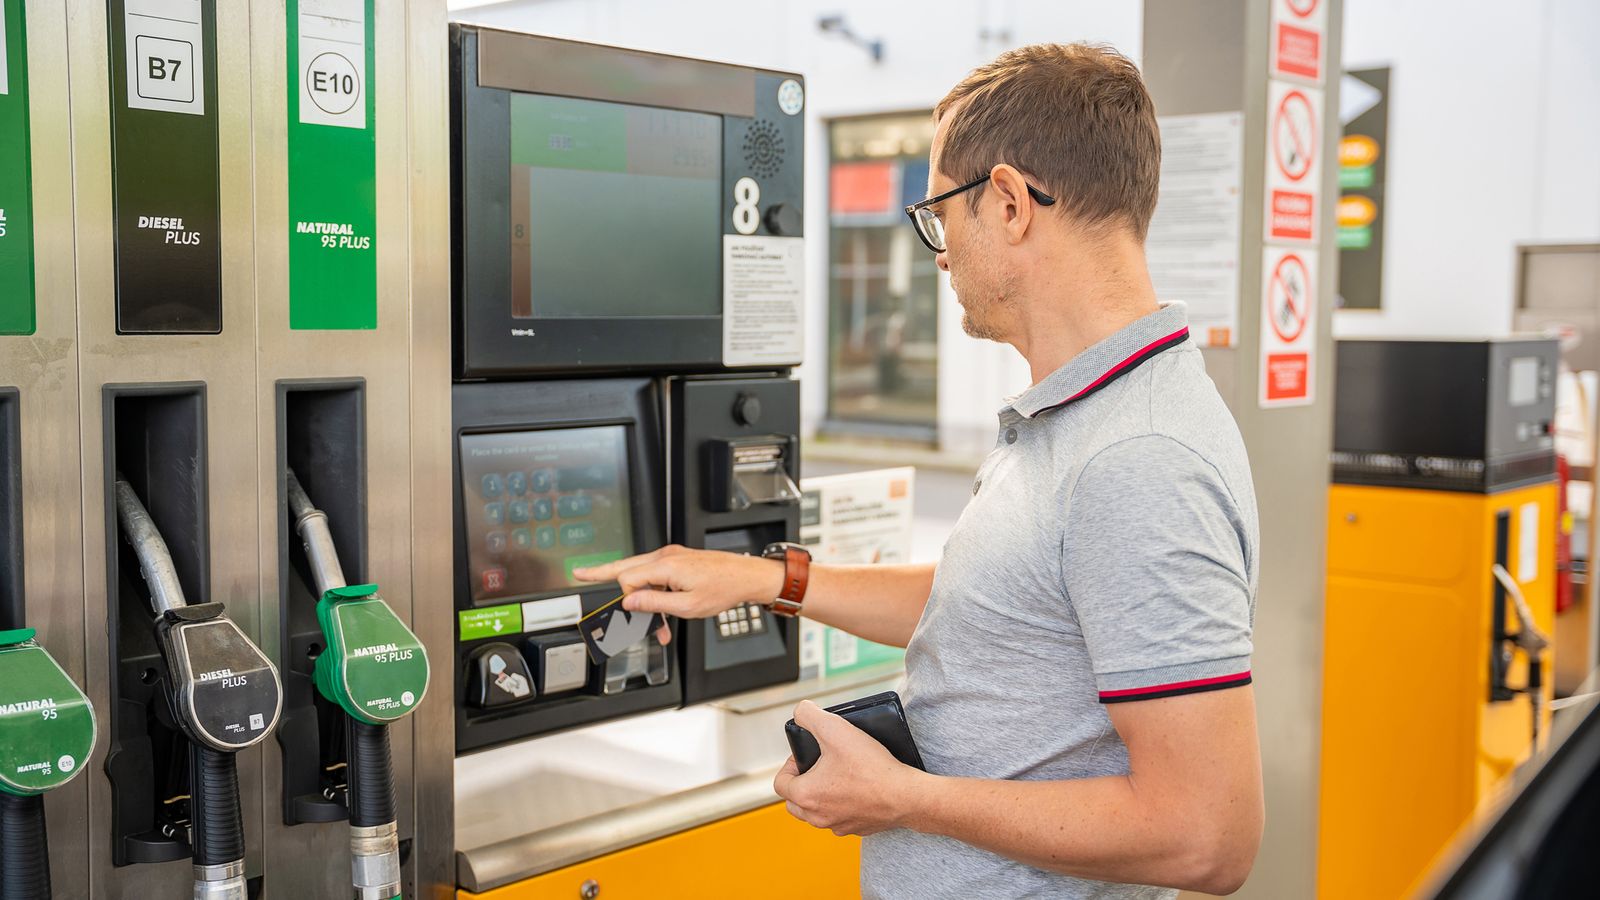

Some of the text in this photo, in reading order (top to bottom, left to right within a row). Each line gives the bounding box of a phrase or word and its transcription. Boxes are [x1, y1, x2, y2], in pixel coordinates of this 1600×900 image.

[148, 56, 182, 82] B7
[313, 71, 353, 95] E10
[732, 176, 760, 235] 8
[138, 216, 184, 230] DIESEL
[296, 222, 354, 235] NATURAL
[165, 230, 201, 245] PLUS
[514, 224, 524, 239] 8
[321, 235, 370, 249] 95 PLUS
[567, 528, 586, 539] DEL
[354, 643, 399, 657] NATURAL
[375, 649, 413, 663] 95 PLUS
[200, 669, 234, 681] DIESEL
[222, 675, 247, 688] PLUS
[0, 698, 56, 714] NATURAL
[367, 697, 393, 707] NATURAL
[386, 701, 401, 709] PLUS
[42, 708, 57, 720] 95
[17, 761, 51, 773] NATURAL
